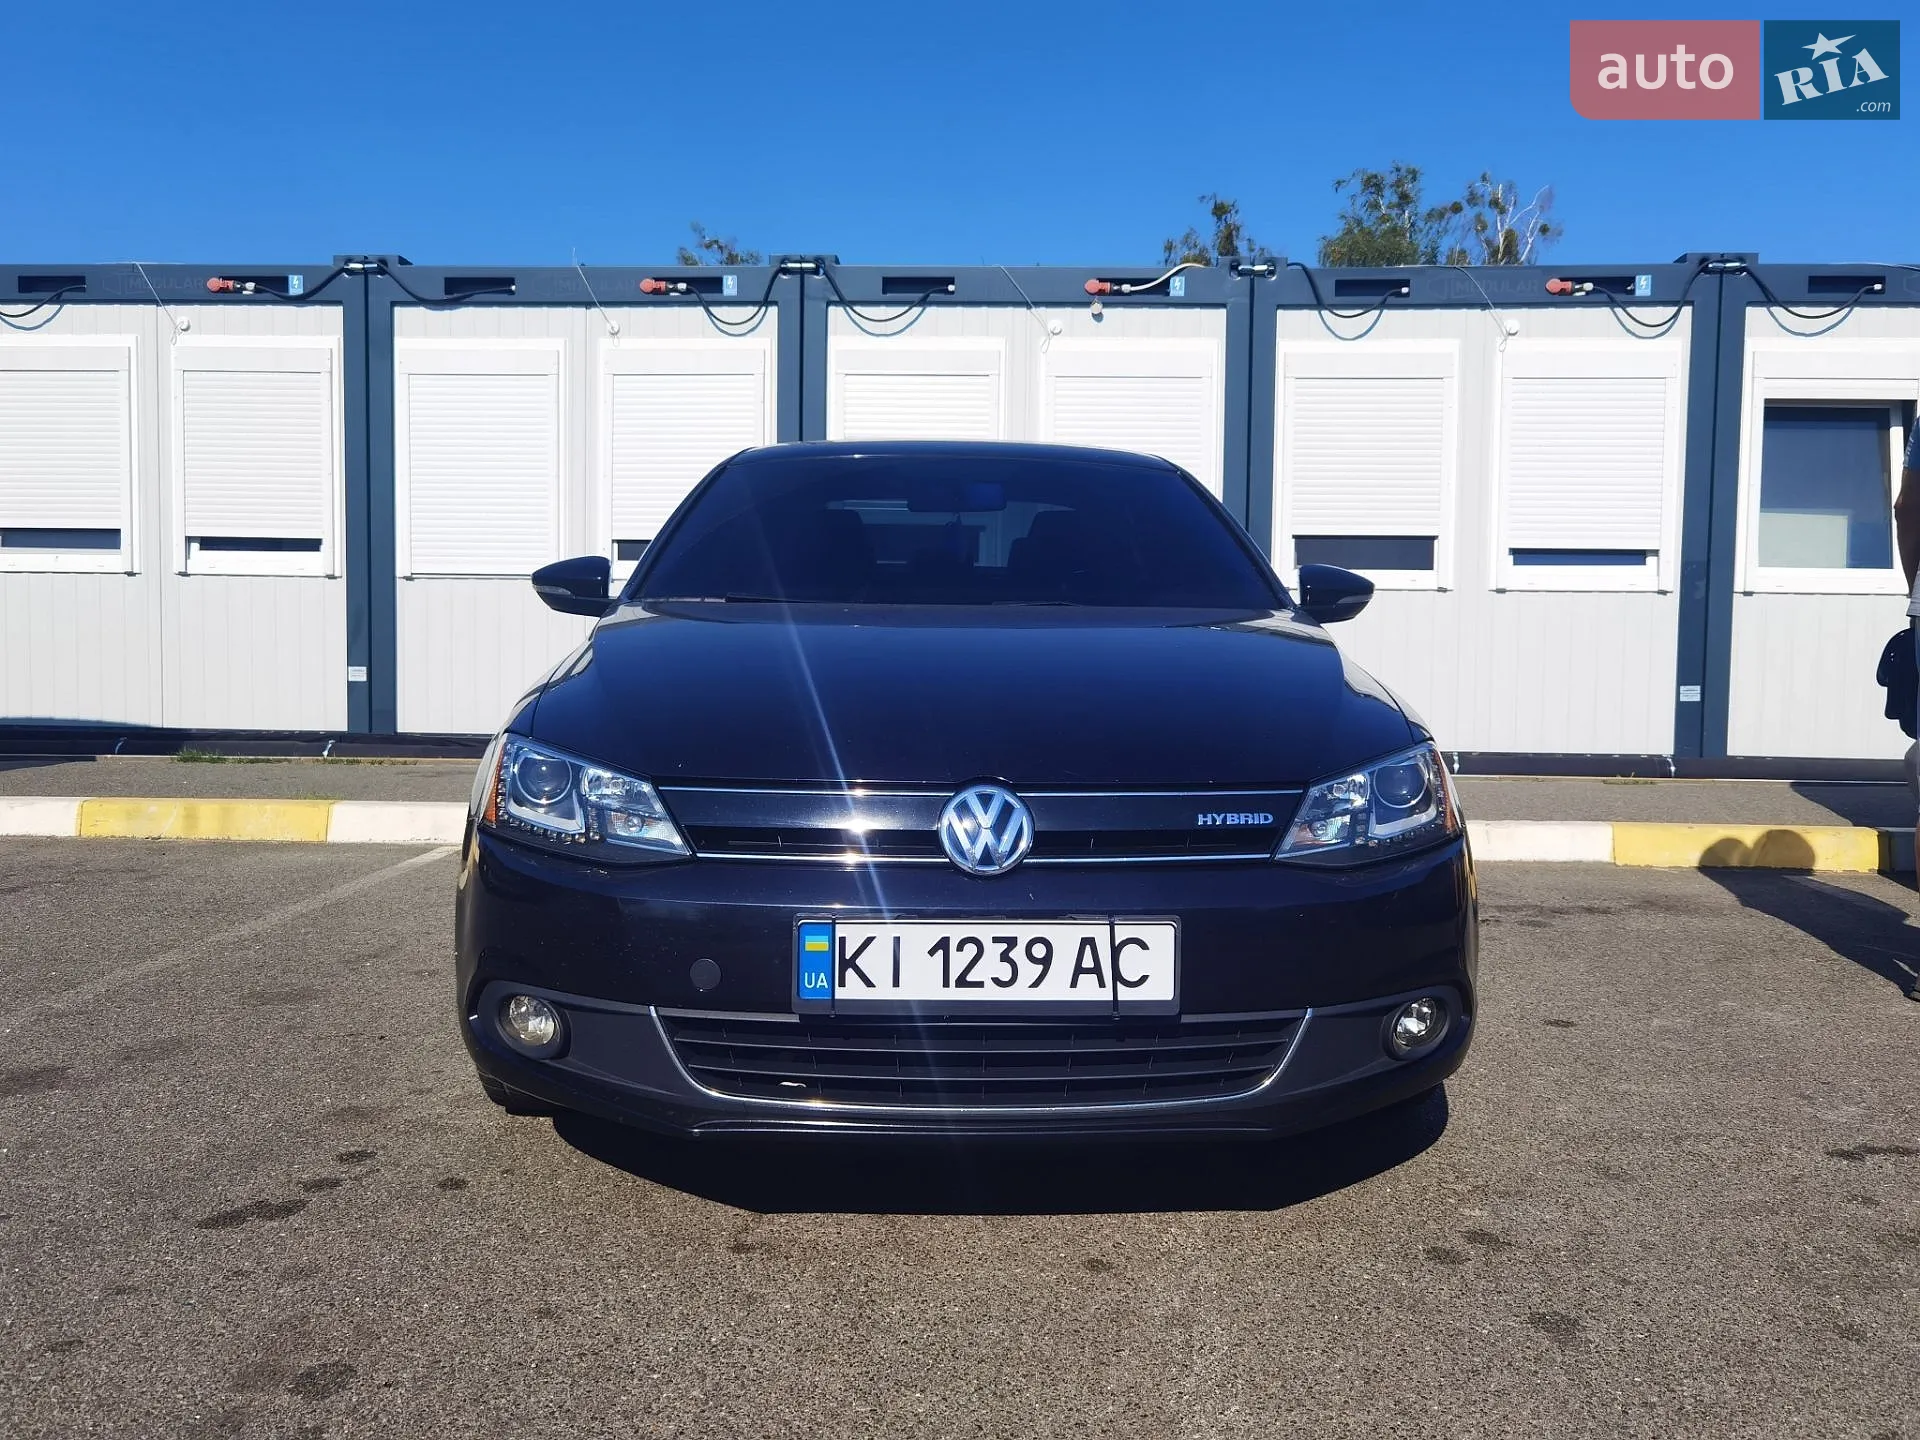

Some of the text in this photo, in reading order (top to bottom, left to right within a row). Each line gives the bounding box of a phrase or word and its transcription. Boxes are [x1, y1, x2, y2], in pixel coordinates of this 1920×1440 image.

[1197, 812, 1274, 826] HYBRID
[837, 935, 1151, 989] KI 1239 AC
[804, 971, 828, 989] UA
